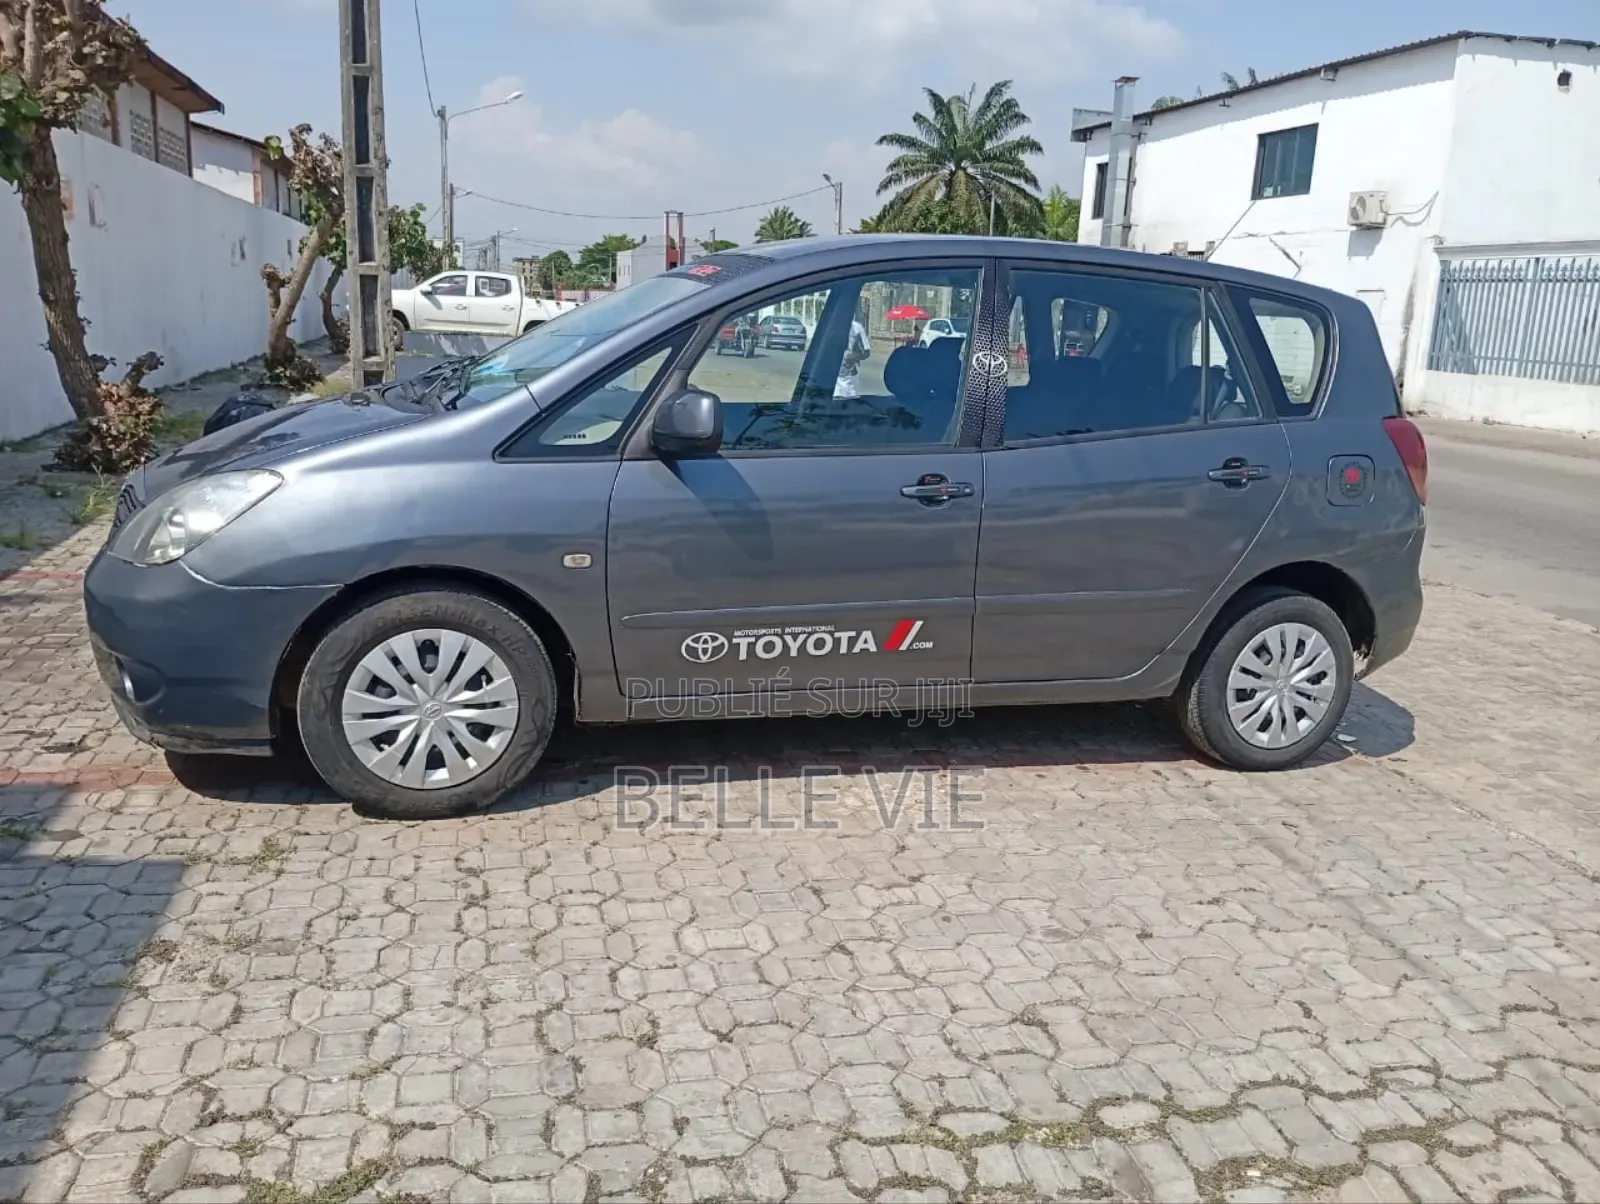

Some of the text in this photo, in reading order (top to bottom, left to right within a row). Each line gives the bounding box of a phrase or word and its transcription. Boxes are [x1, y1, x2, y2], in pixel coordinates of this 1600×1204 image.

[733, 624, 835, 636] MOTORSPORTS INTERNATIONAL
[732, 630, 934, 661] TOYOTA .COM
